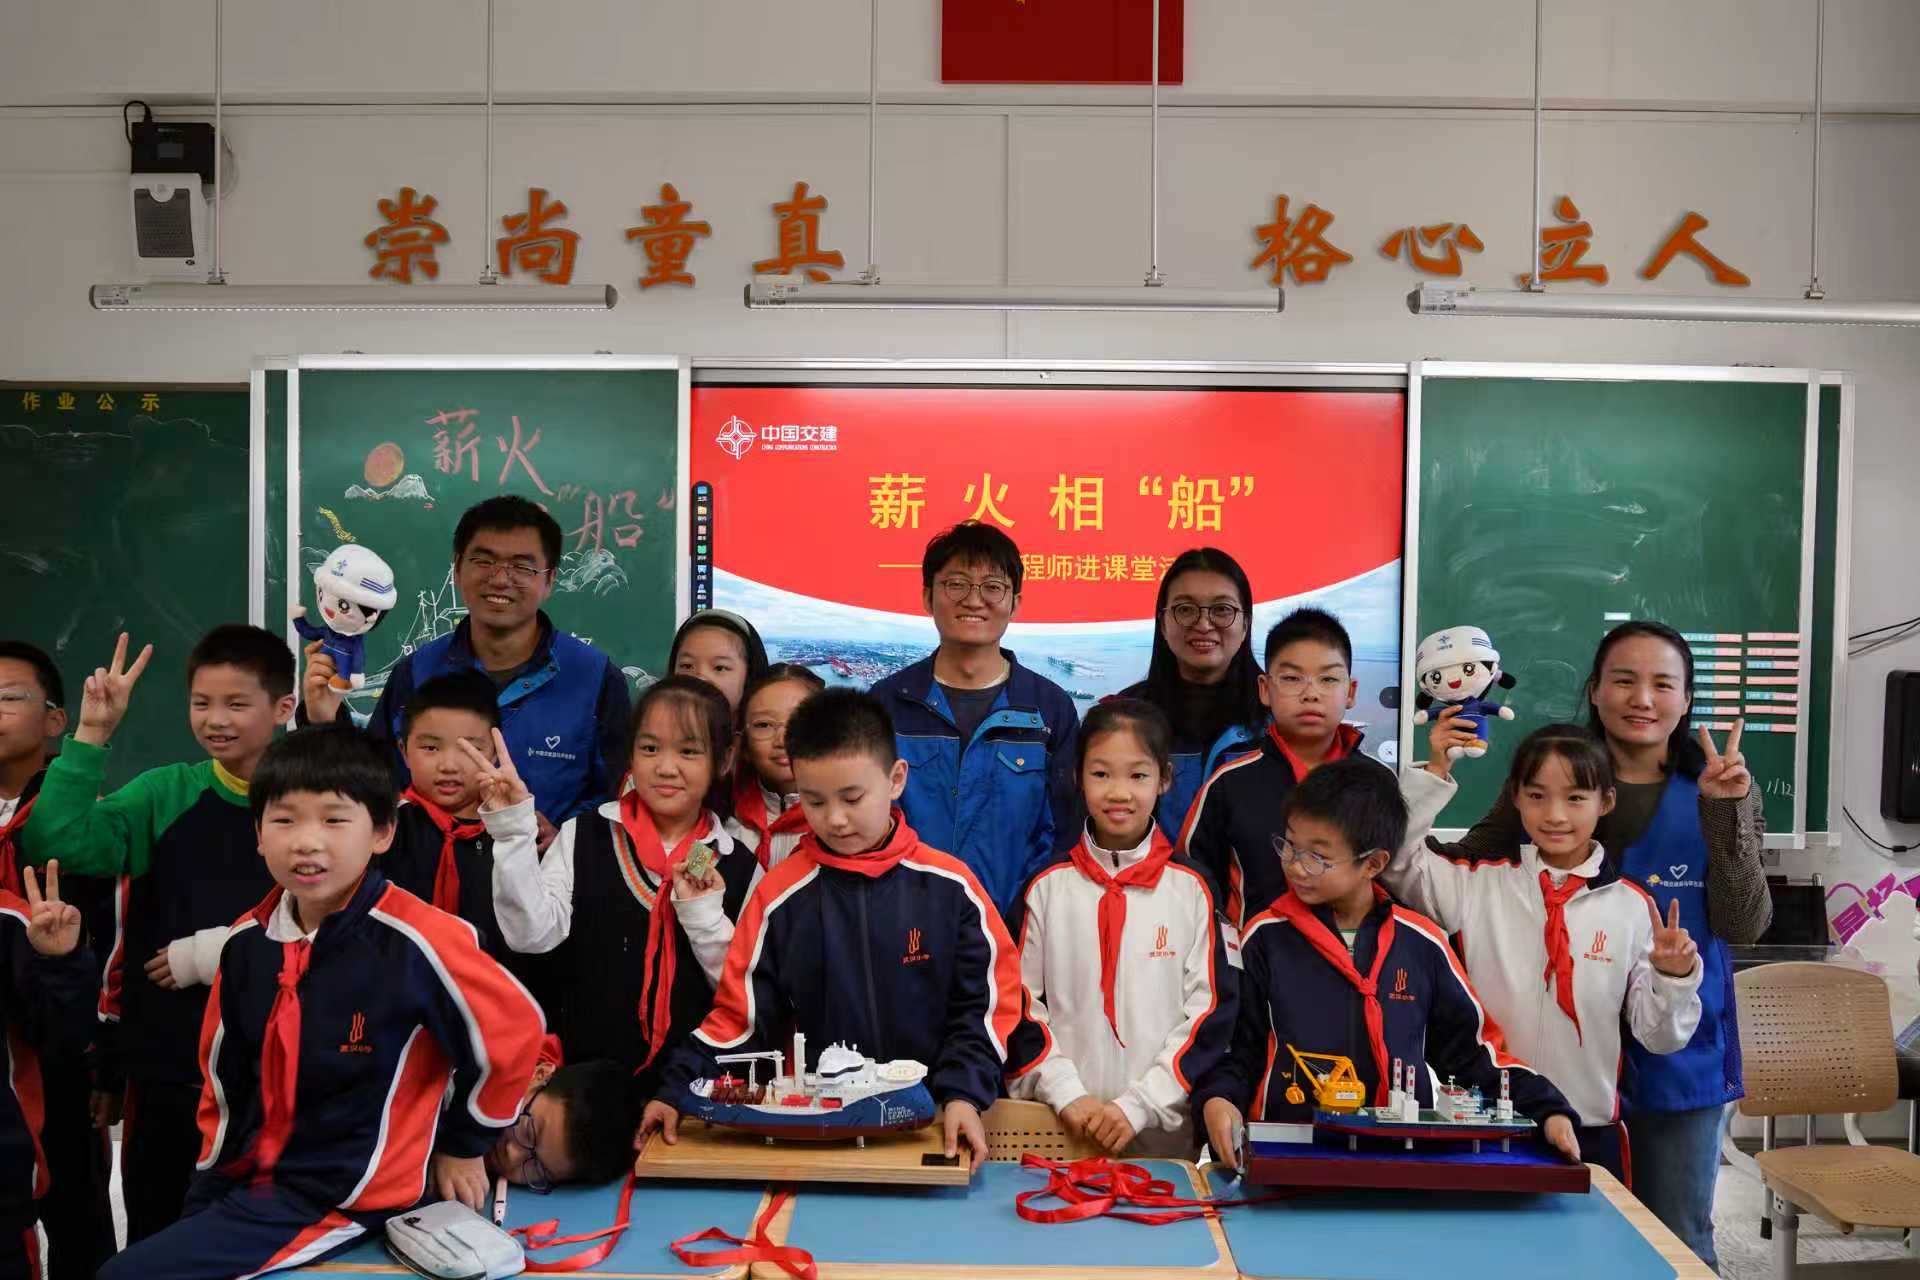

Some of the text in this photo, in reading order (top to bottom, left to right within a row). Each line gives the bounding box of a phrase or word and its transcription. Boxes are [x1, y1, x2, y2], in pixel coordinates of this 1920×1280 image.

[364, 181, 1751, 288] 崇尚童真 格心立人
[22, 391, 161, 412] 作业公示
[425, 408, 556, 497] 薪火
[761, 425, 838, 442] 中国交建
